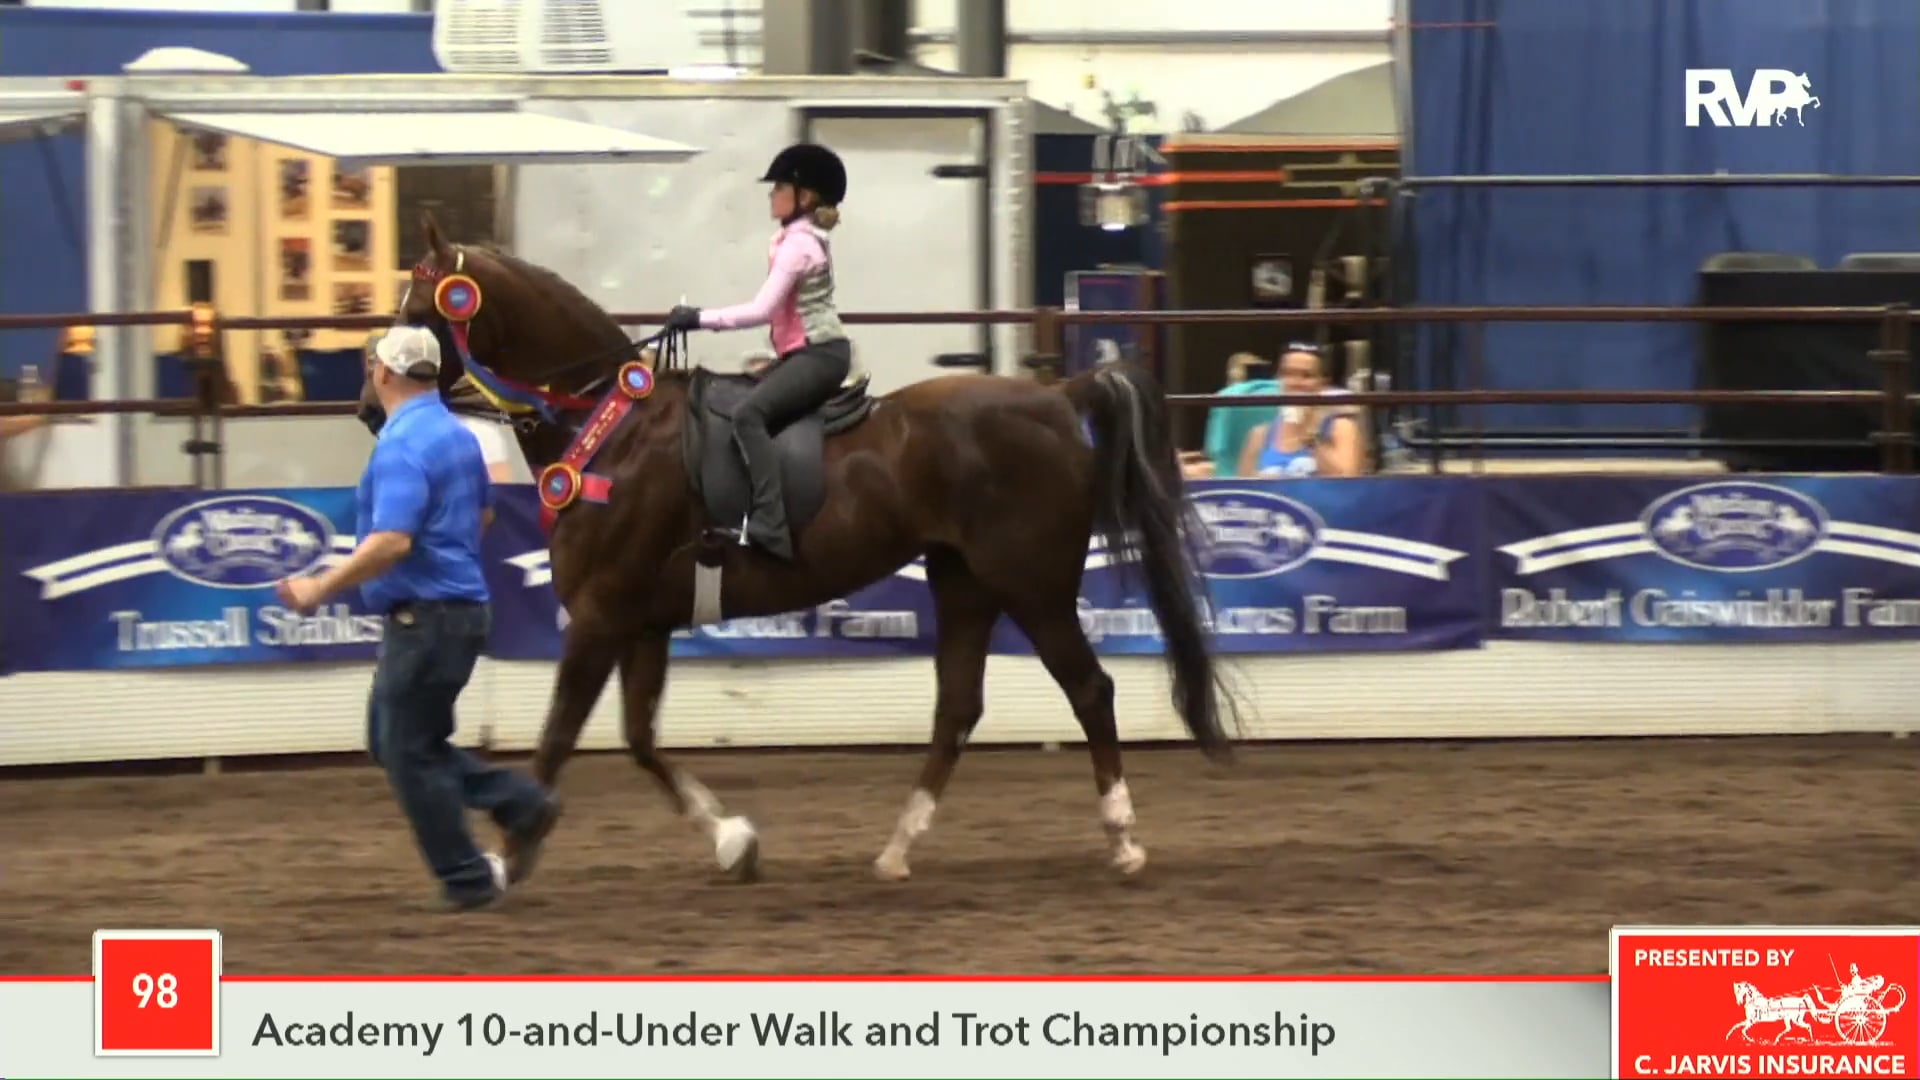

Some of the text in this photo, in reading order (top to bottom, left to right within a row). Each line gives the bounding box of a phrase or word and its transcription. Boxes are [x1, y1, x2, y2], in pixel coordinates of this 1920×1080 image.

[110, 603, 384, 651] Trussell Stables
[815, 599, 918, 638] Farm
[1303, 594, 1407, 634] Farm
[1501, 588, 1624, 627] Robert
